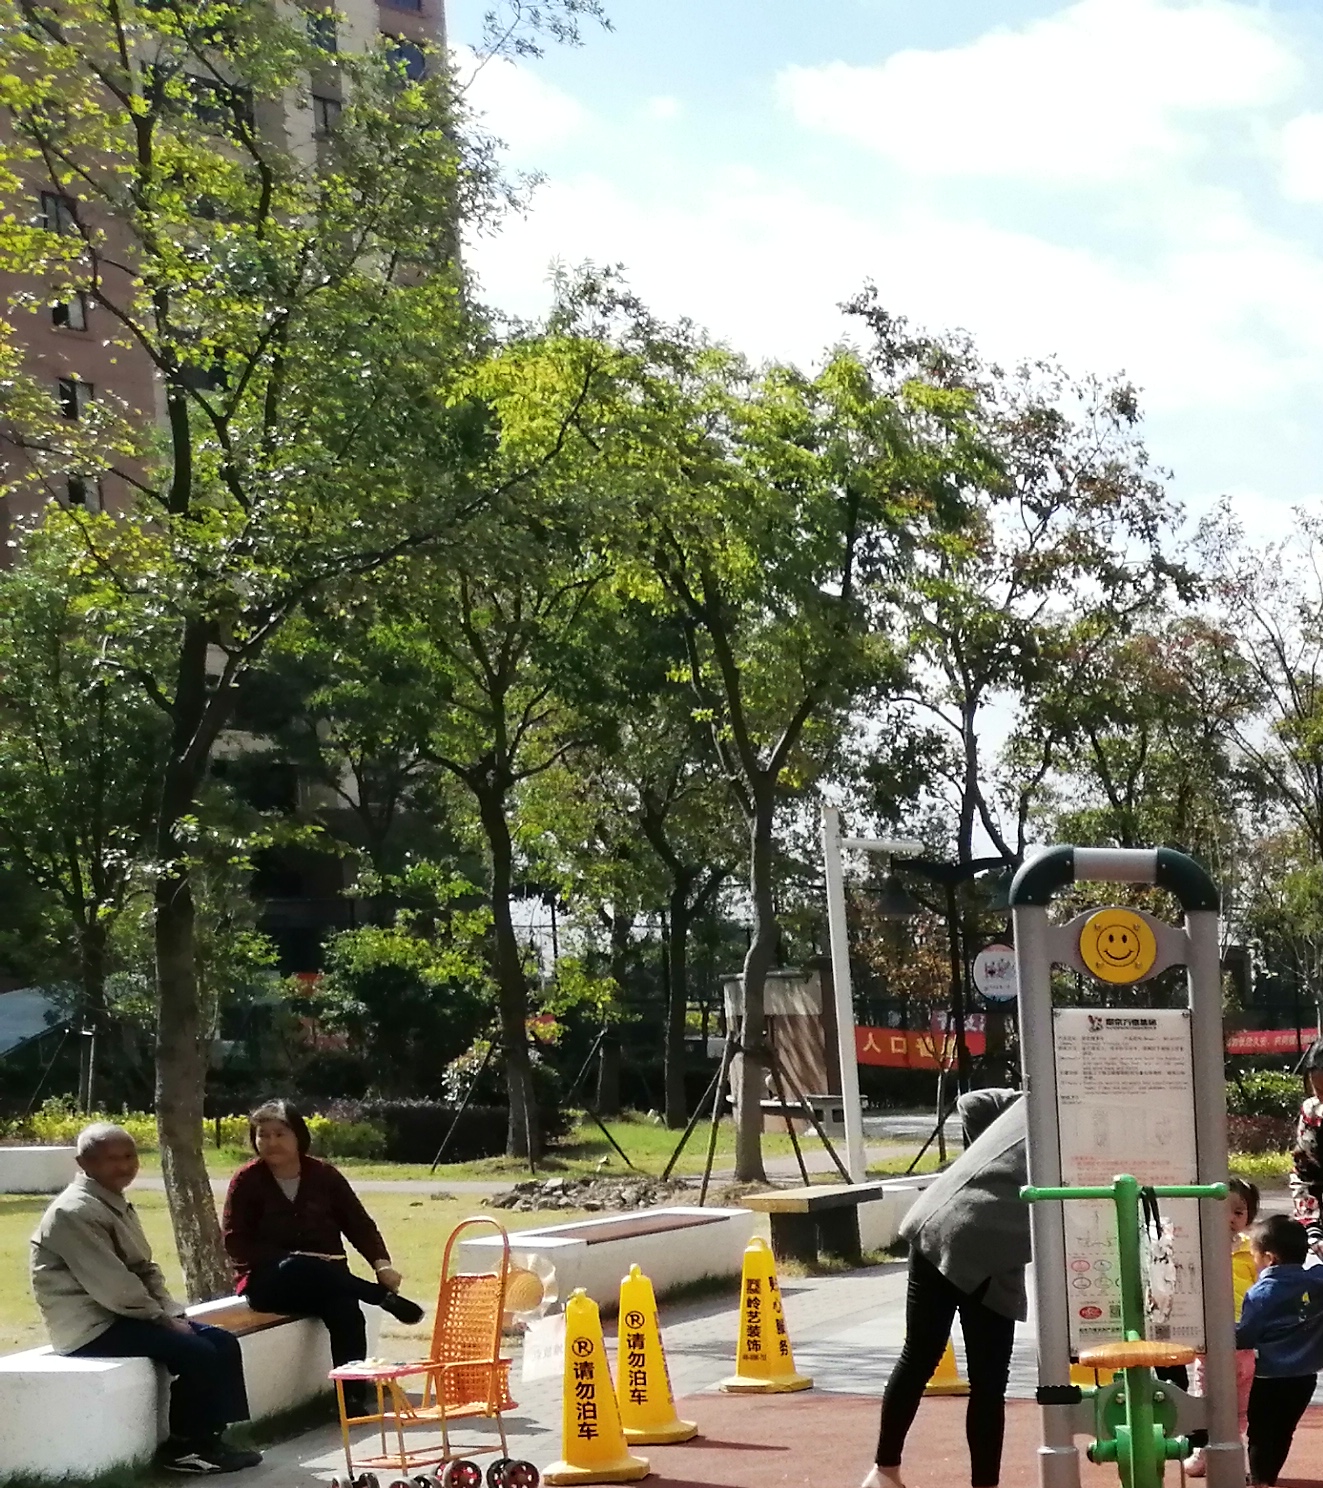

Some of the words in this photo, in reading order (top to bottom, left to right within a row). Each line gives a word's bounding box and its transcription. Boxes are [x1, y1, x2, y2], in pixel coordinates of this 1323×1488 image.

[768, 1276, 789, 1357] 贴心服务
[573, 1361, 598, 1440] 请勿泊车
[625, 1332, 649, 1406] 请勿泊车
